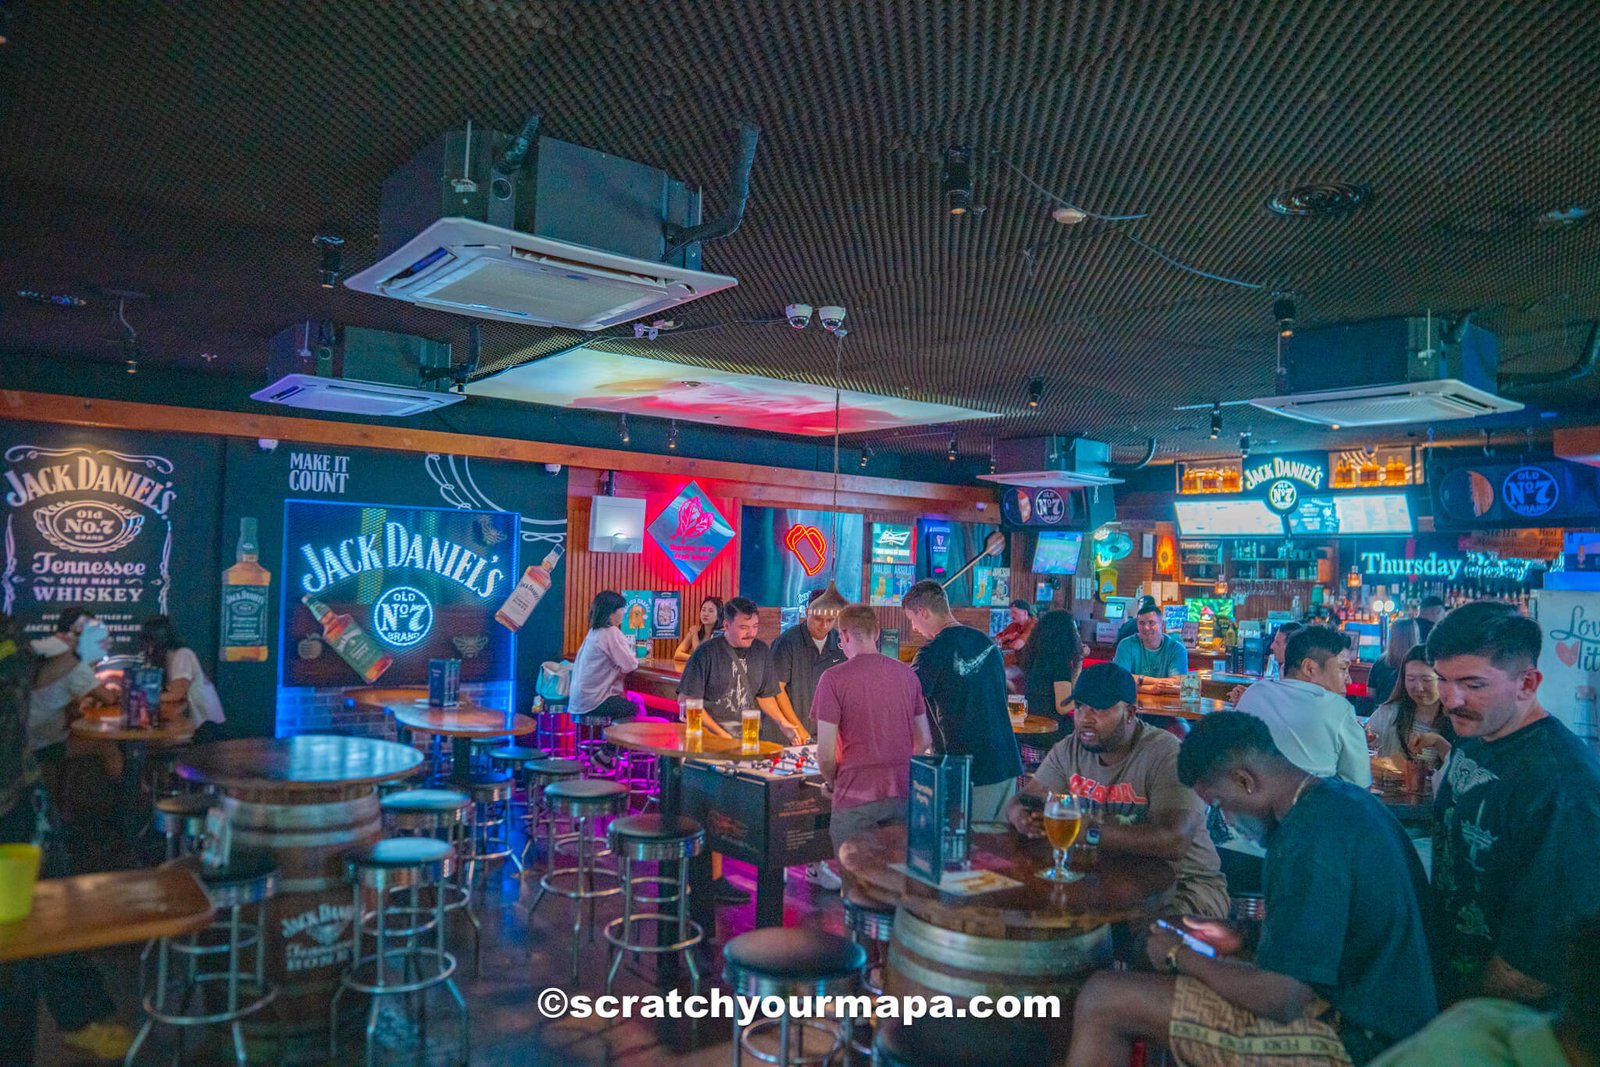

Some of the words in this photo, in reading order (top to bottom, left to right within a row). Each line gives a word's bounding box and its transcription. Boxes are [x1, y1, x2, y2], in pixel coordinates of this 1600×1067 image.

[290, 452, 330, 472] MAKE
[334, 456, 350, 472] IT
[1244, 463, 1275, 490] JACK
[1273, 457, 1324, 490] DANIEL'S
[5, 464, 77, 507] JACK
[77, 455, 177, 515] DANIEL'S
[289, 470, 349, 493] COUNT
[1517, 470, 1540, 480] OLD
[31, 551, 146, 576] Tennessee
[301, 534, 383, 592] JACK
[385, 521, 504, 598] DANIEL'S
[1360, 552, 1463, 580] Thursday
[33, 586, 143, 602] WHISKEY
[393, 592, 416, 601] OLD
[387, 632, 420, 642] BRAND
